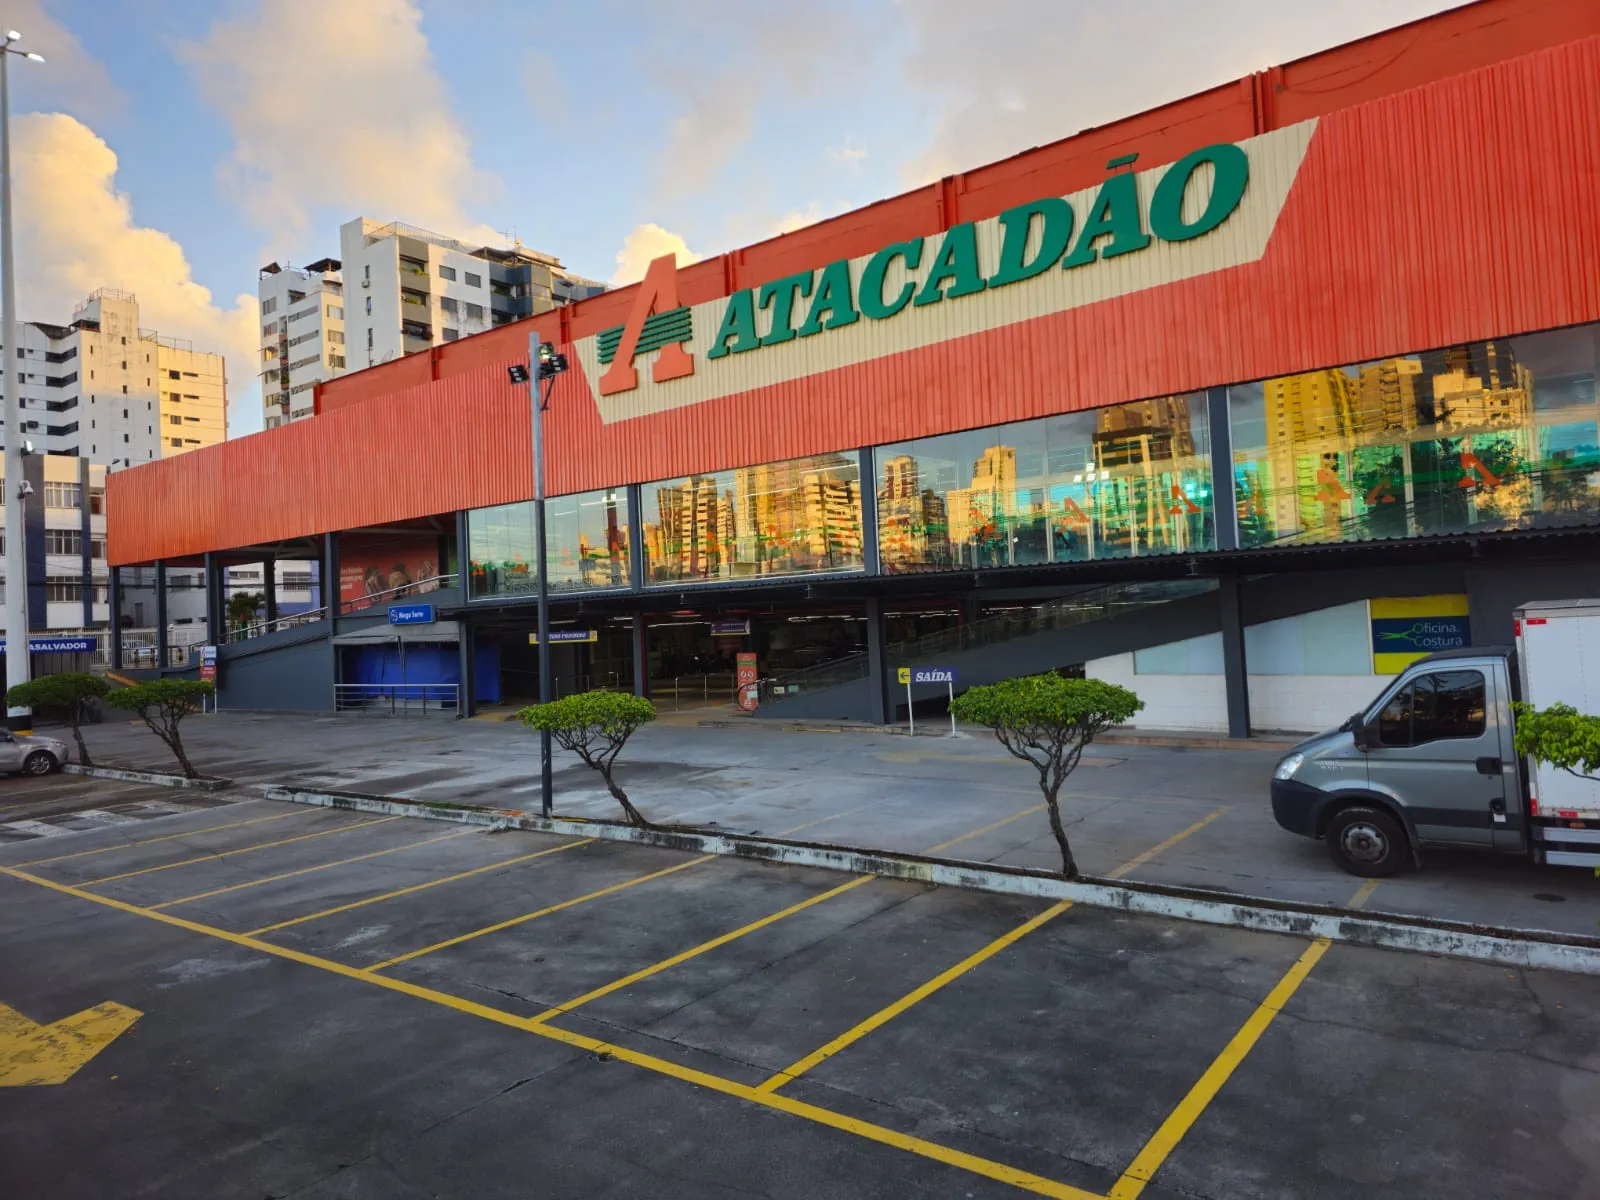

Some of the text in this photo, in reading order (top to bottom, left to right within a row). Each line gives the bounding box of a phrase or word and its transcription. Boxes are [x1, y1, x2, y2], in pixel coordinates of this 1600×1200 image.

[706, 142, 1250, 360] ATACADÃO
[1411, 622, 1457, 634] Oficina
[1414, 636, 1463, 647] Costura
[916, 668, 952, 682] SAÍDA
